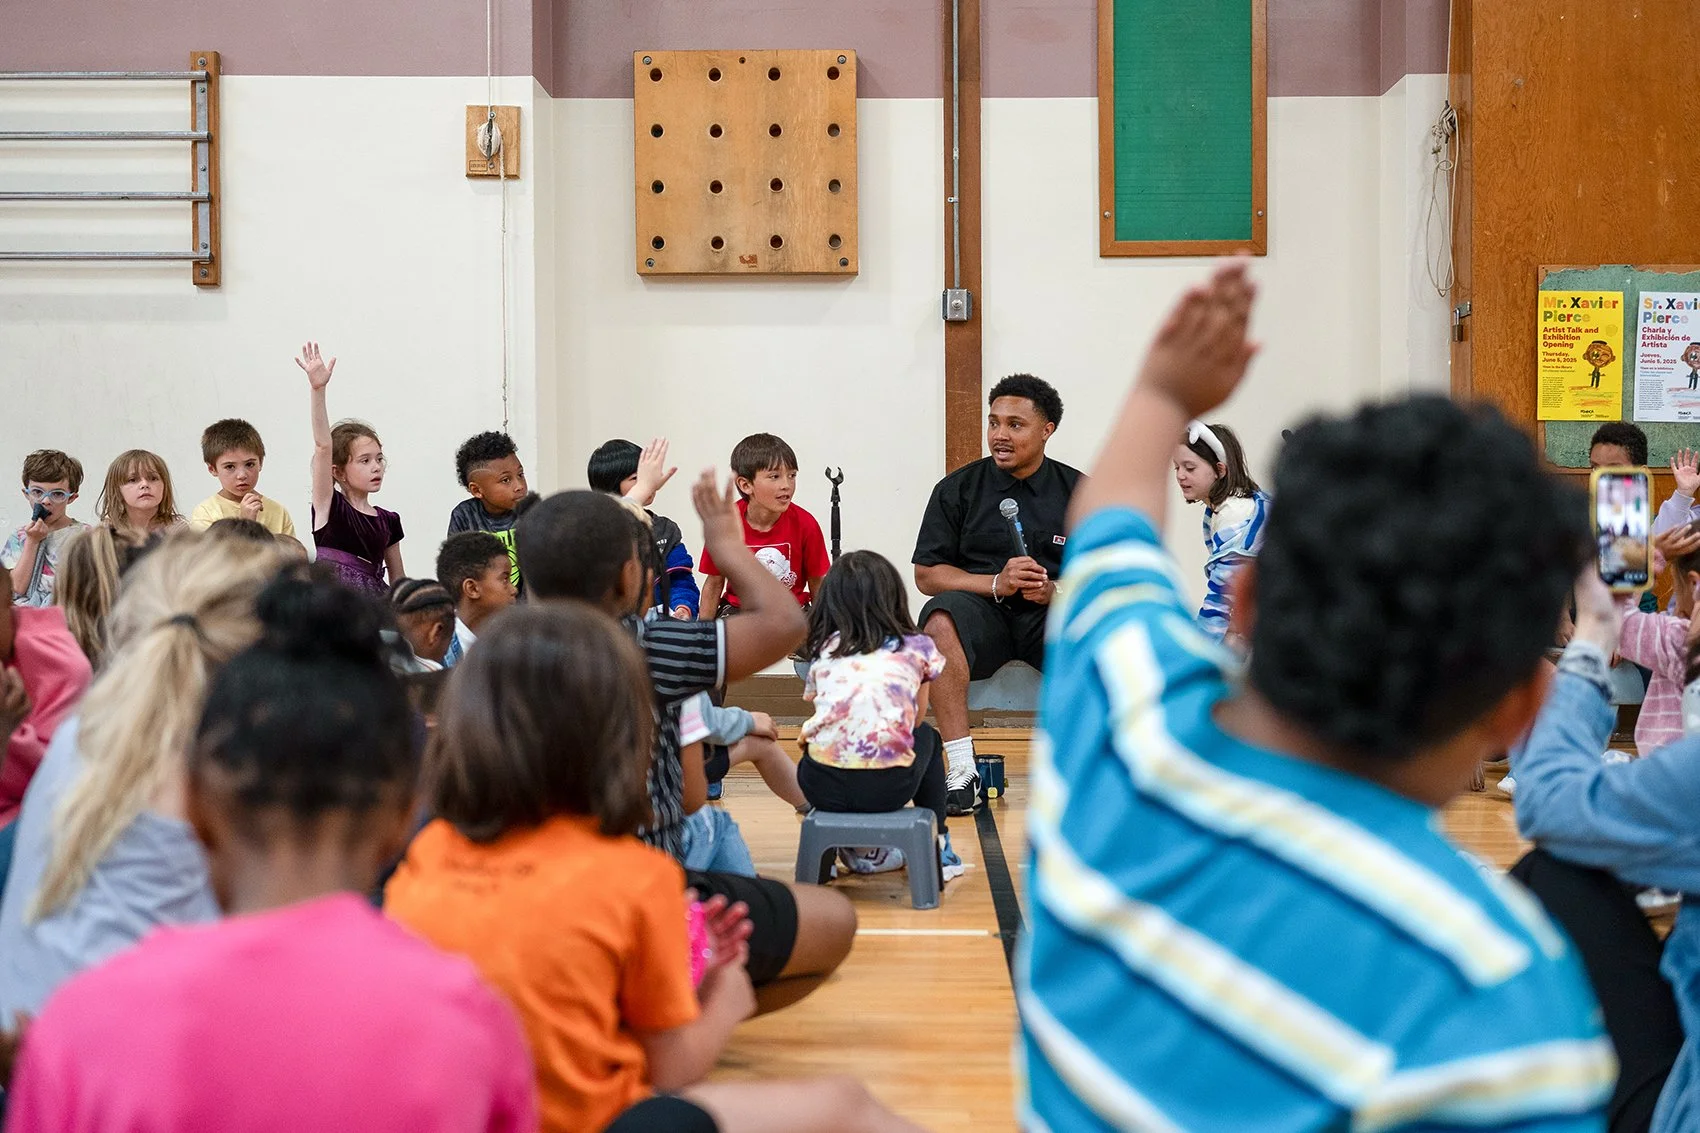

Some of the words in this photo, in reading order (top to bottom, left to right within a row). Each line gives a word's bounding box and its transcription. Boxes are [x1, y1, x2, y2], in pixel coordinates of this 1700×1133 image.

[1544, 297, 1566, 308] Mr.
[1570, 296, 1618, 308] Xavier
[1644, 297, 1662, 309] Sr.
[1666, 298, 1700, 310] Xavi
[1544, 310, 1590, 322] Pierce
[1643, 311, 1688, 324] Pierce
